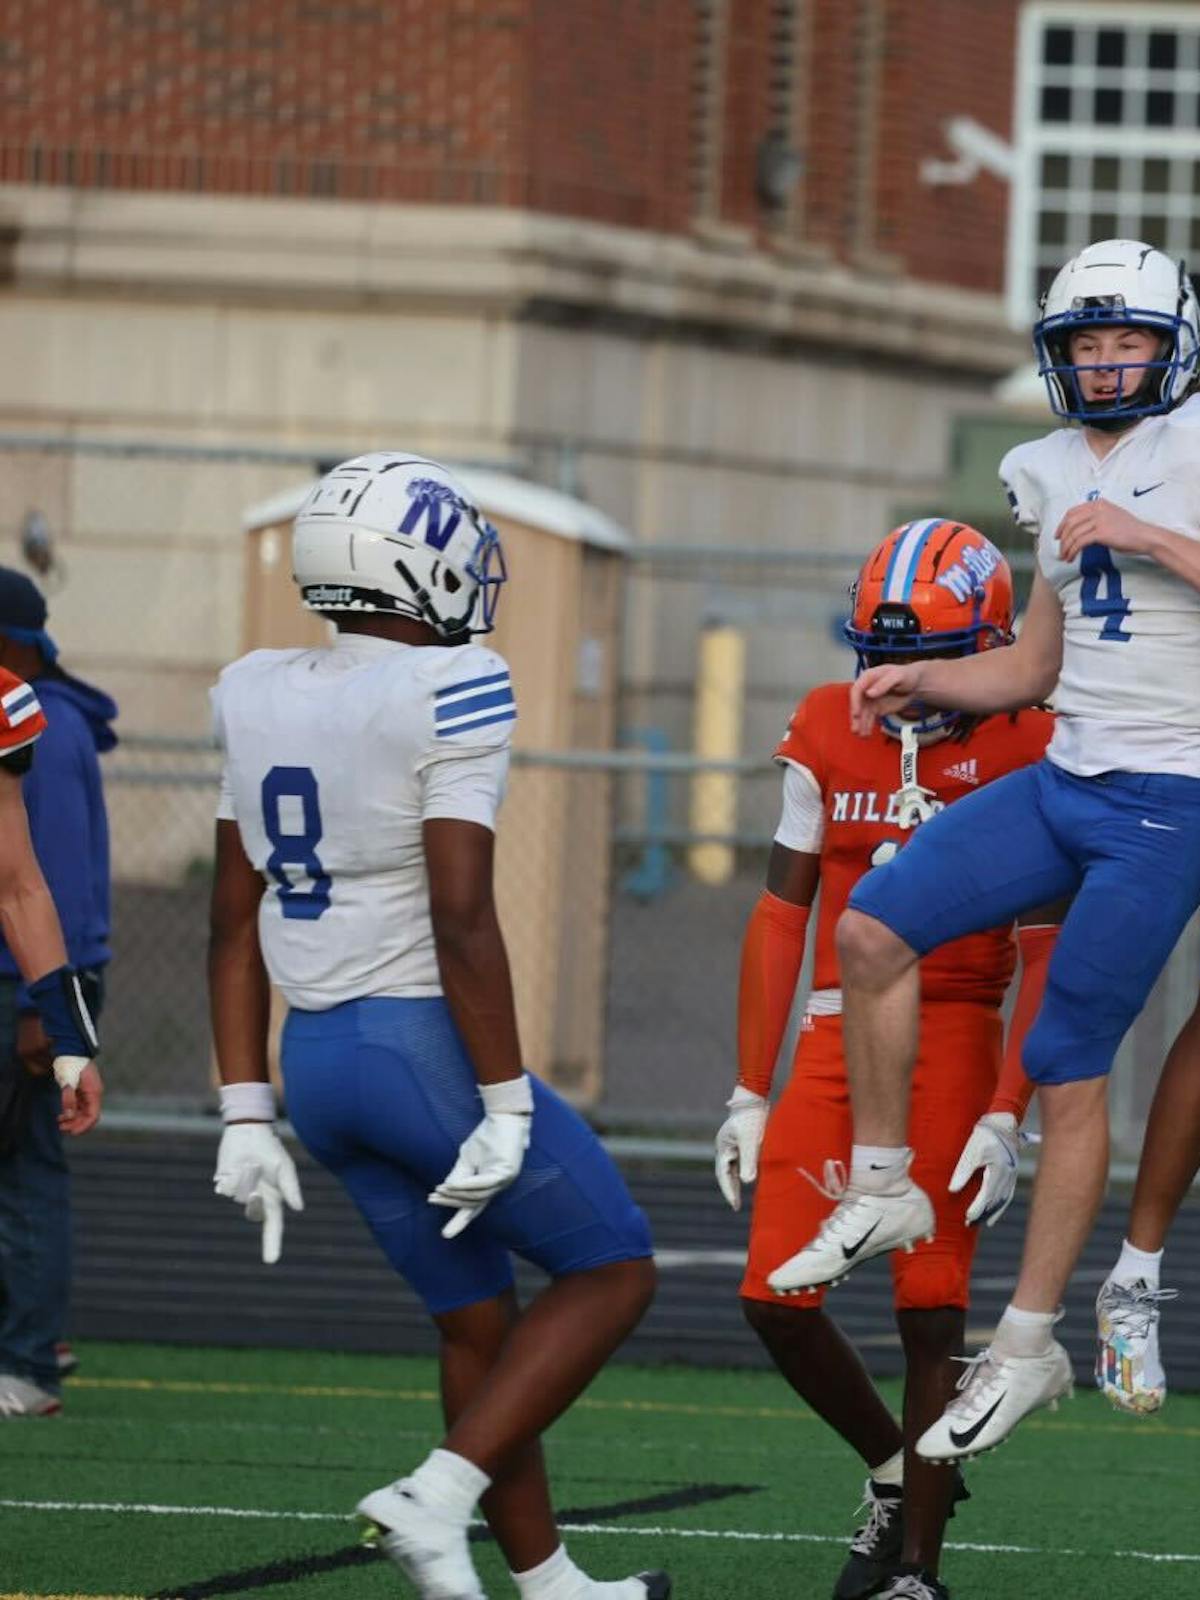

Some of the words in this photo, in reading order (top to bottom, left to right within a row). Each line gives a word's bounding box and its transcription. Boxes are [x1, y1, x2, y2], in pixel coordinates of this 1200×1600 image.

[398, 491, 462, 551] N
[307, 585, 352, 601] schutt
[1080, 541, 1132, 642] 4
[882, 617, 905, 629] WIN
[261, 766, 333, 920] 8
